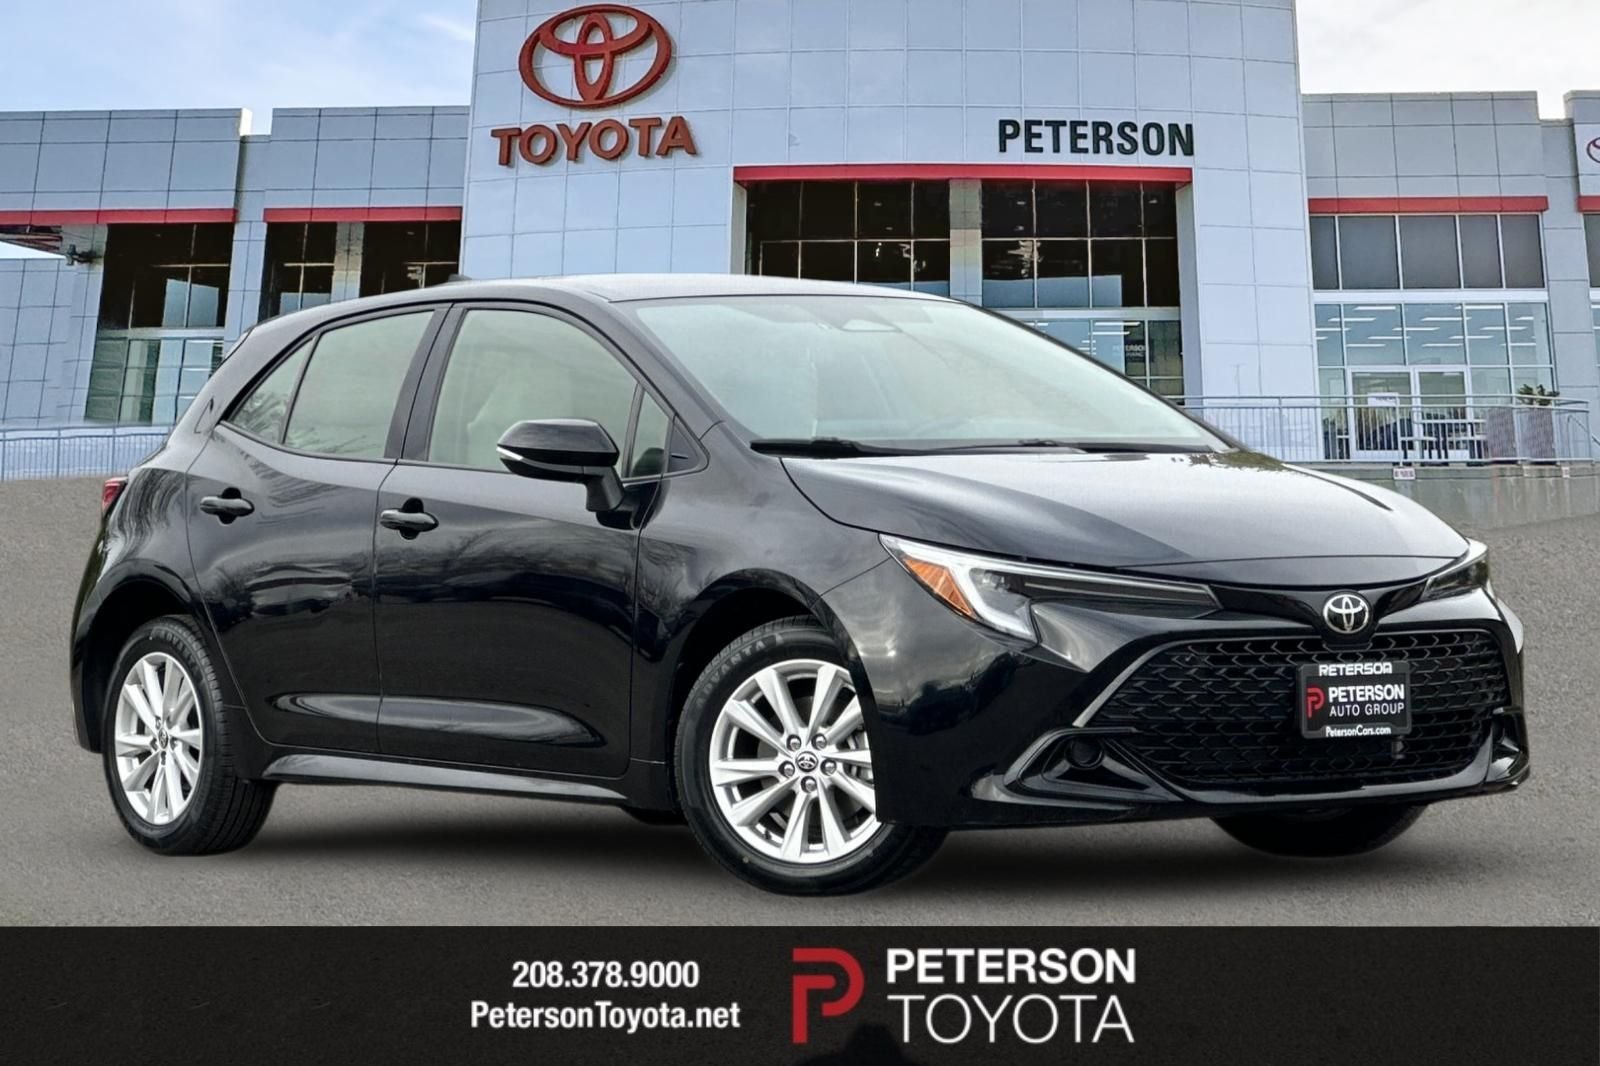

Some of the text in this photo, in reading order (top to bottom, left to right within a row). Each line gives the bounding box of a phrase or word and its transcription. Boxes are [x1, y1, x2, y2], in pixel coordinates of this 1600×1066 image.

[491, 115, 697, 167] TOYOTA
[998, 119, 1194, 157] PETERSON
[1328, 684, 1404, 703] PETERSON
[1329, 702, 1405, 717] AUTO GROUP
[1325, 724, 1391, 737] PetersonCars.com
